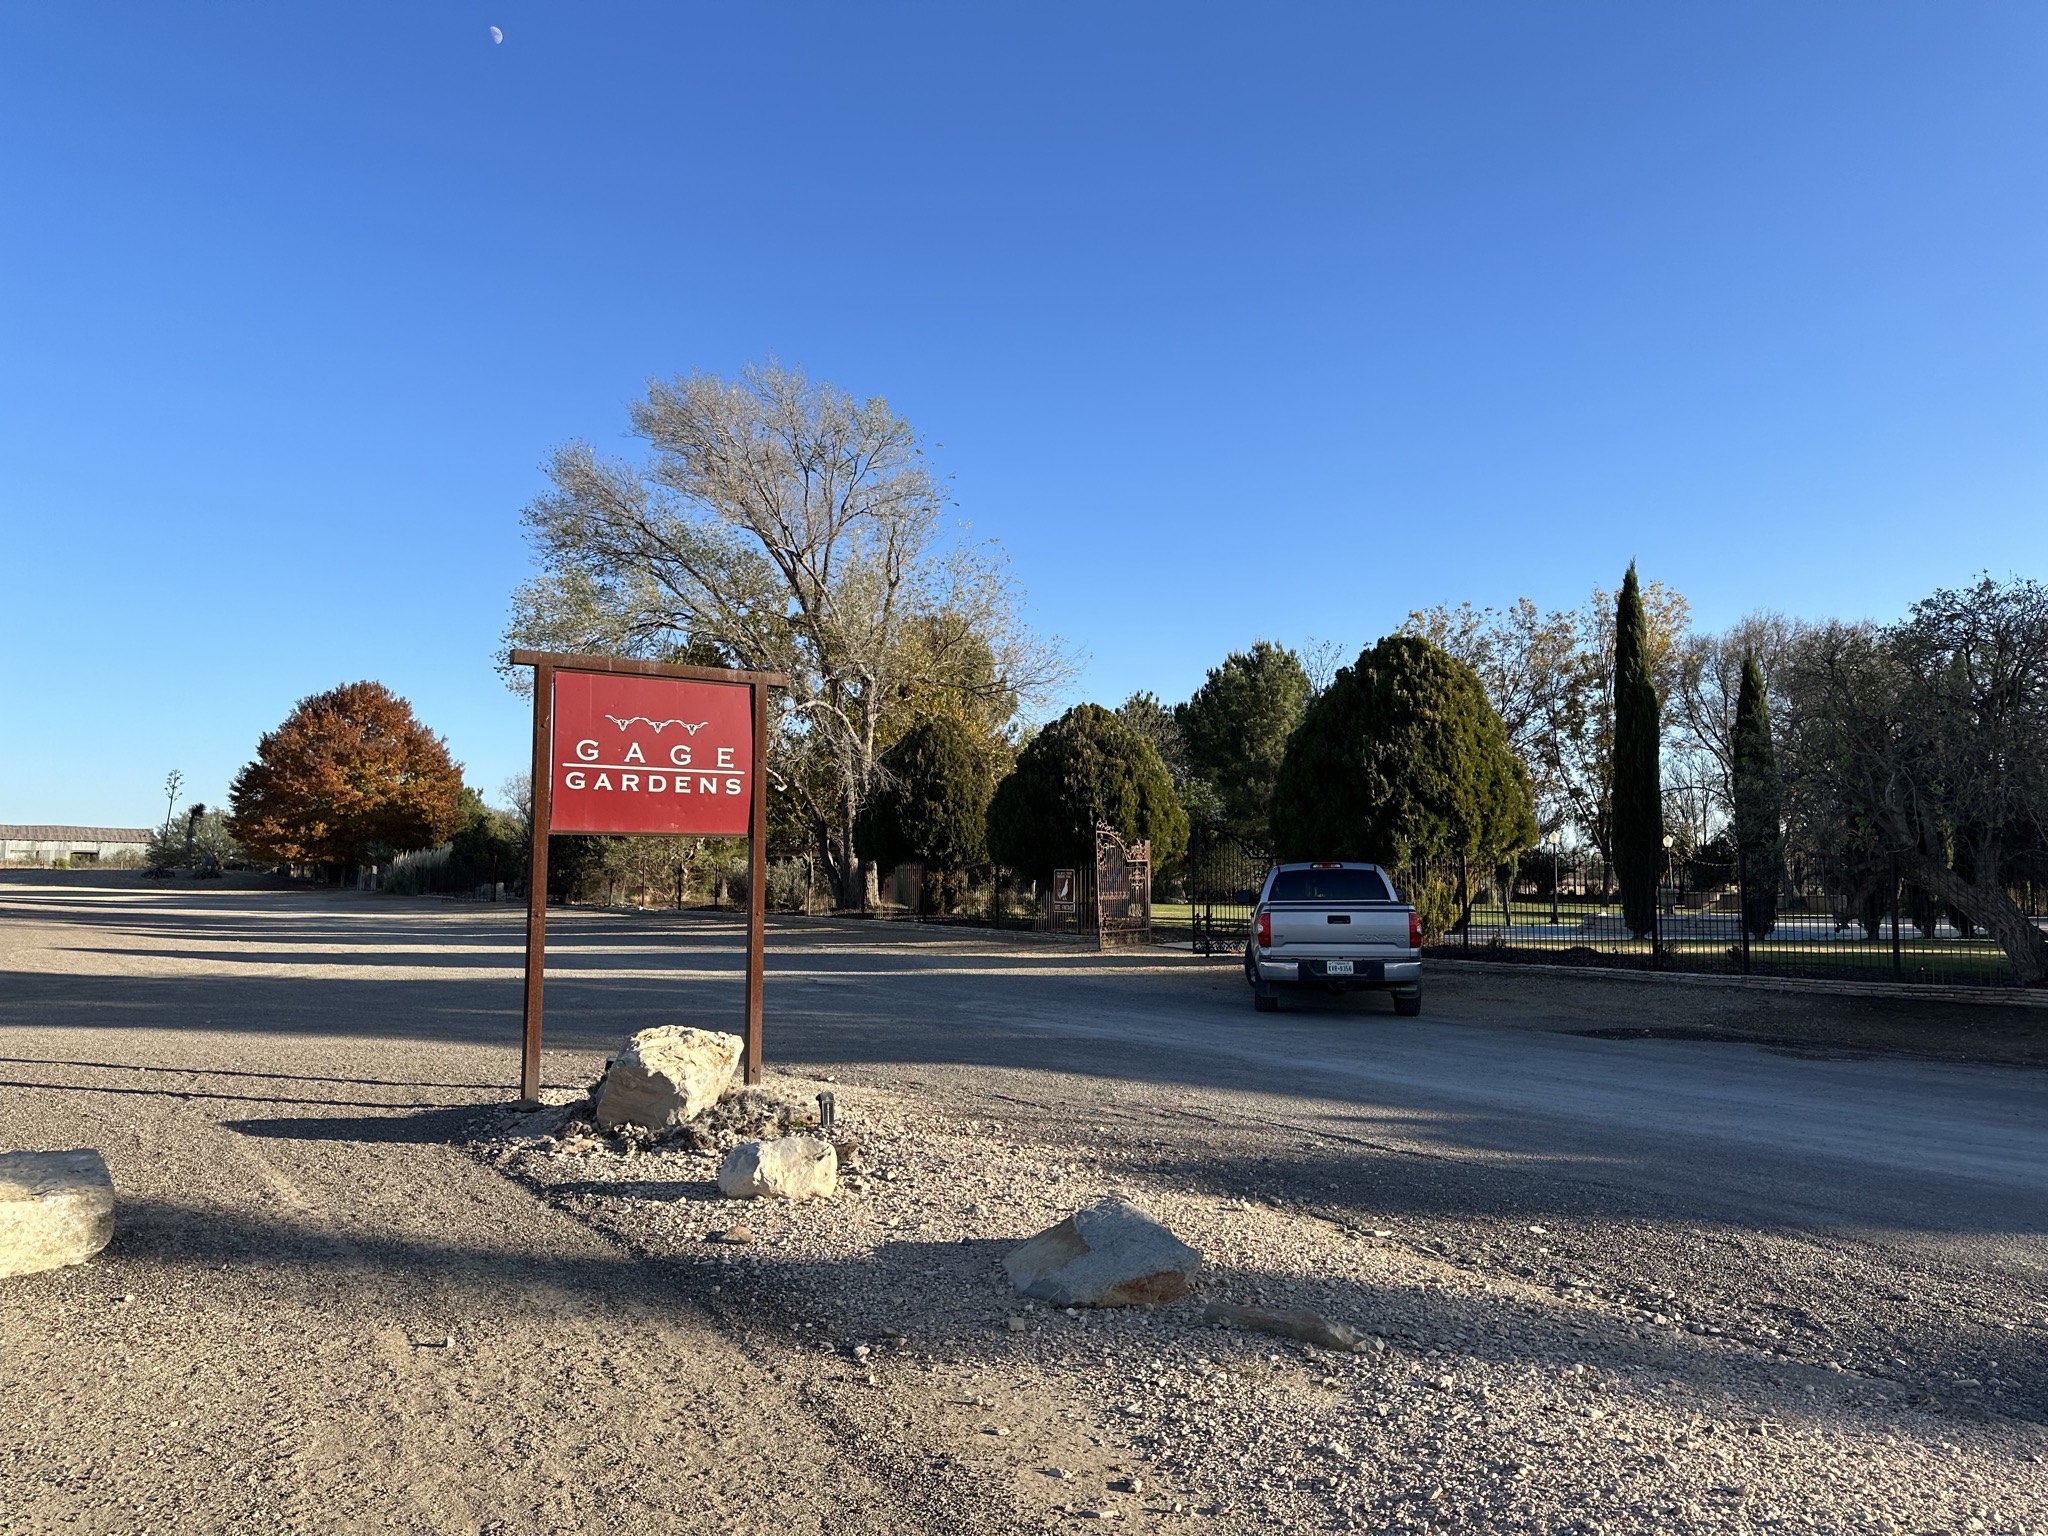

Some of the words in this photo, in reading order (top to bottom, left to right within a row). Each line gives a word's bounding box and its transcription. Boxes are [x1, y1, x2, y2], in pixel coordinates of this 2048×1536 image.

[575, 739, 735, 769] GAGE
[565, 771, 742, 796] GARDENS
[1354, 933, 1407, 942] TUNDRA
